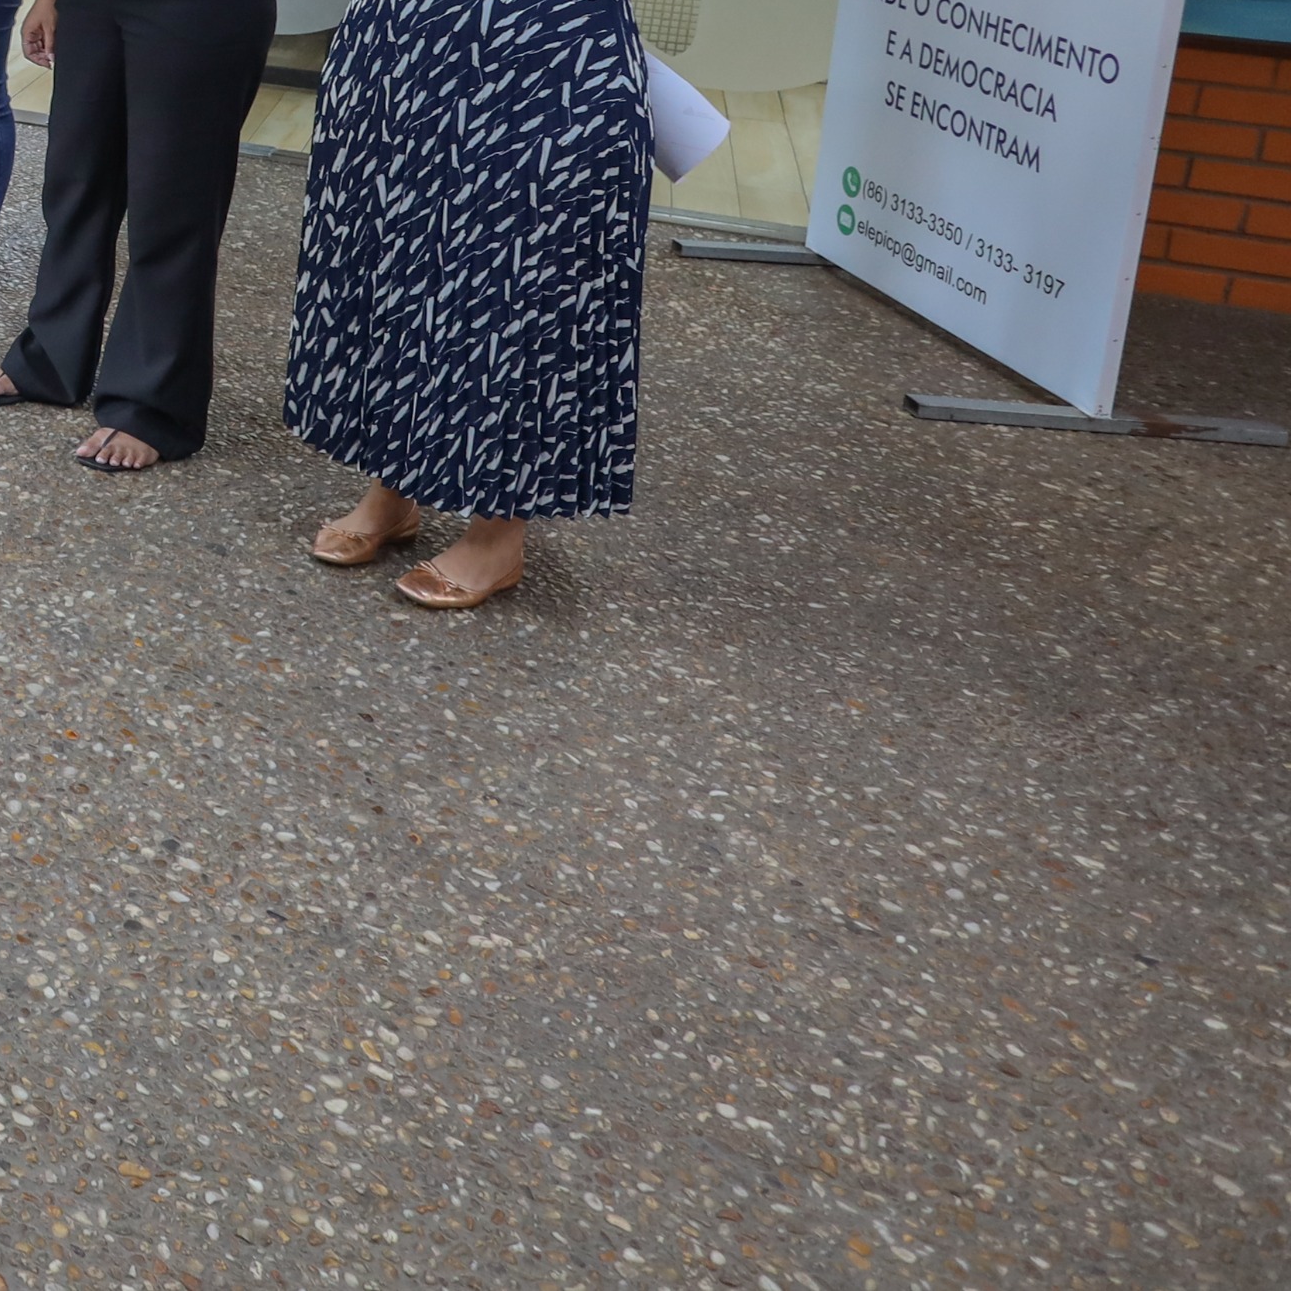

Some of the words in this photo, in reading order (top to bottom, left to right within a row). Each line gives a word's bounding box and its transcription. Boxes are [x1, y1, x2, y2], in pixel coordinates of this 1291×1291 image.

[886, 29, 897, 56] E
[899, 38, 913, 65] A
[919, 42, 1057, 123] DEMOCRACIA
[884, 80, 907, 112] SE
[910, 90, 1041, 173] ENCONTRAM
[856, 218, 988, 306] elepicp@gmail.com
[862, 178, 888, 210] (86)
[890, 193, 964, 247] 3133-3350
[965, 233, 974, 251] /
[975, 238, 1019, 274] 3133-
[1023, 263, 1066, 300] 3197
